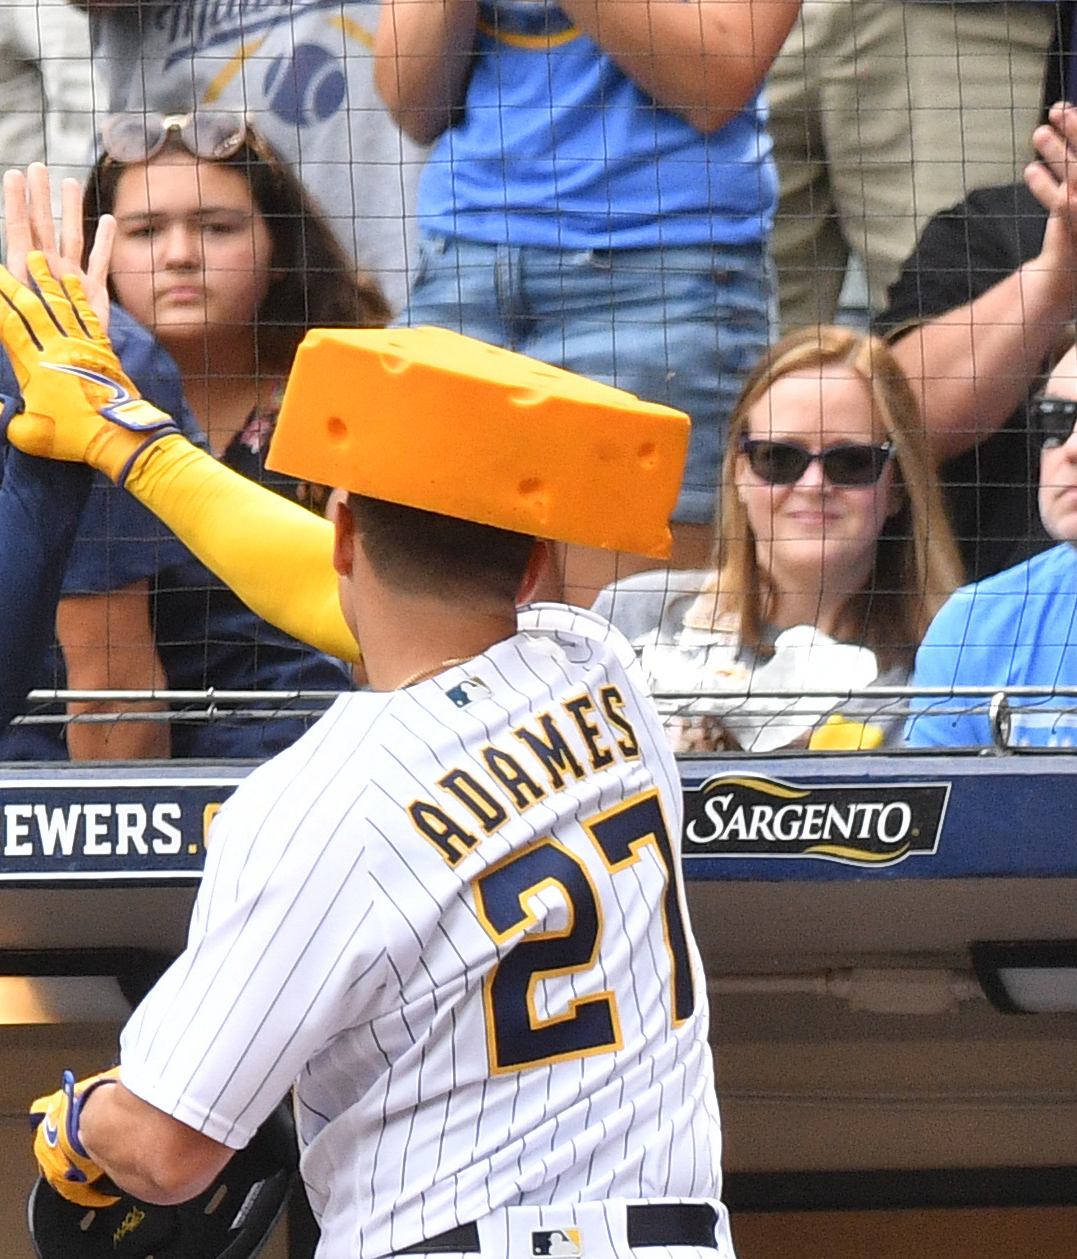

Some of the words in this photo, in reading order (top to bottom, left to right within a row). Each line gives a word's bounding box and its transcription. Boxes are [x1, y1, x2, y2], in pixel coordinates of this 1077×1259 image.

[406, 683, 642, 868] ADAMES
[686, 793, 912, 843] SARGENTO
[471, 787, 697, 1076] 27
